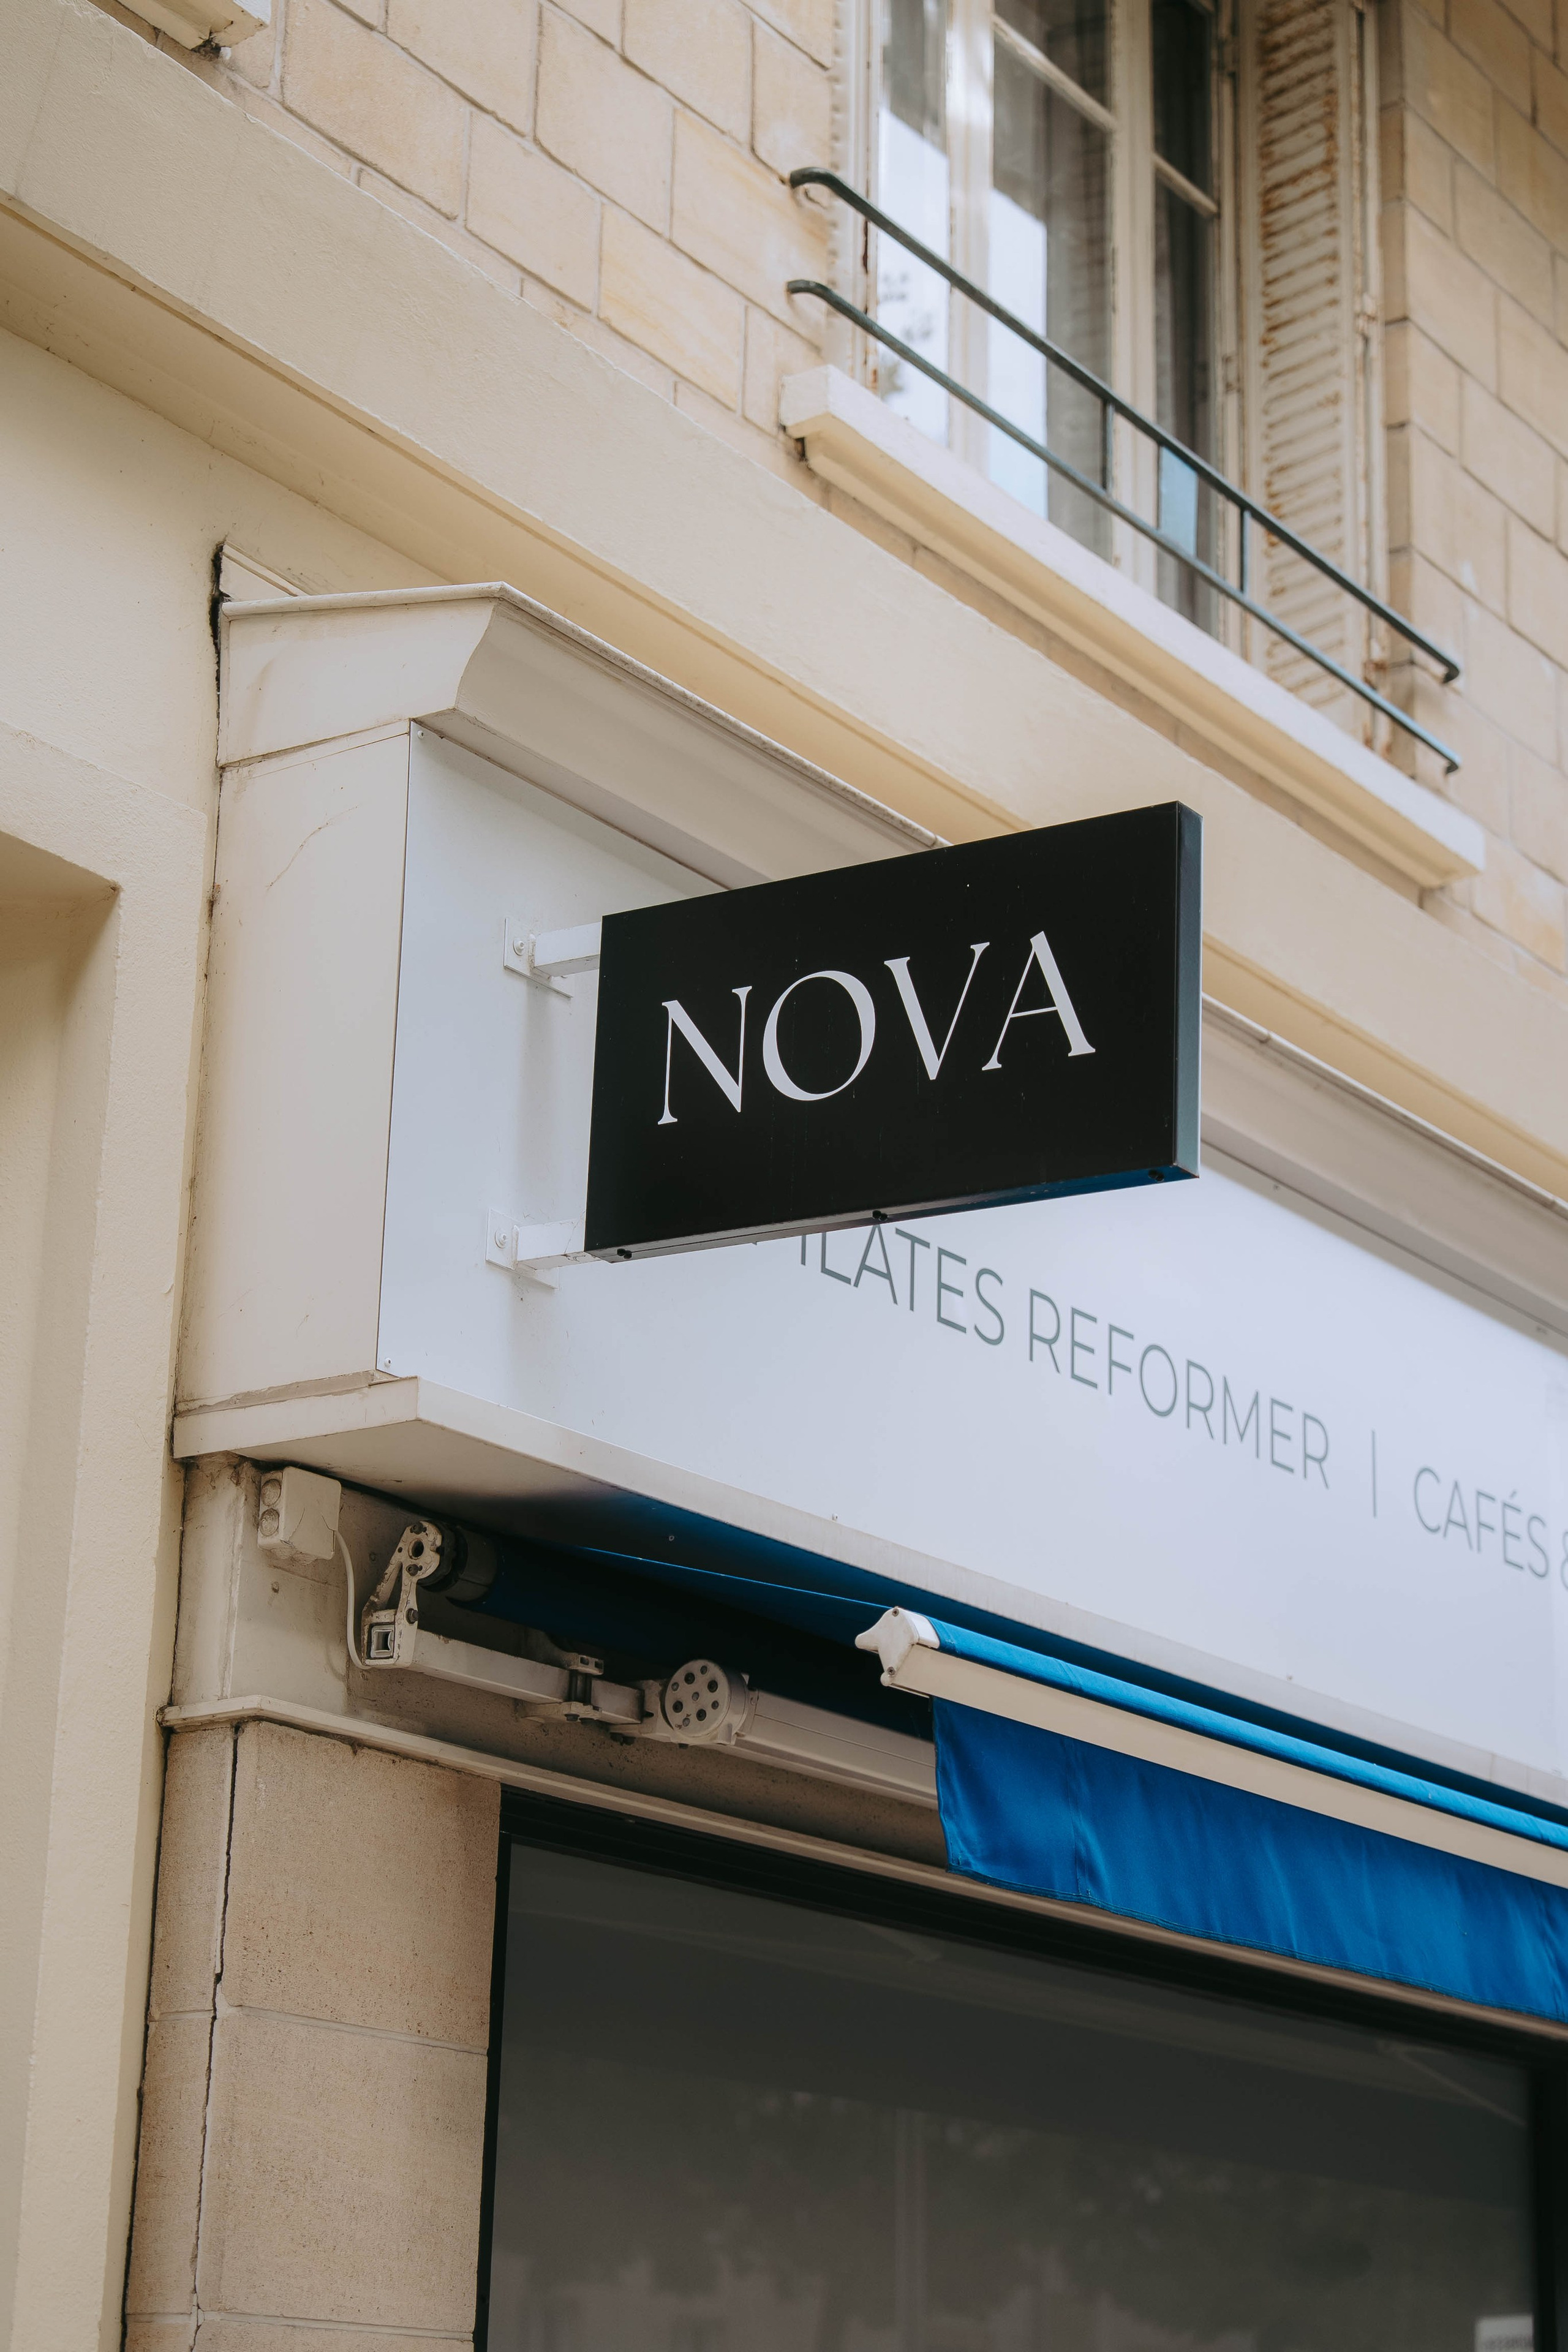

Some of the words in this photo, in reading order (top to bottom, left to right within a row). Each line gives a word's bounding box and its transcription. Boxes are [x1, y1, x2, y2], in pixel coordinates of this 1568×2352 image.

[657, 931, 1096, 1125] NOVA
[1029, 1287, 1330, 1490] REFORMER
[1414, 1466, 1550, 1580] CAFÉS
